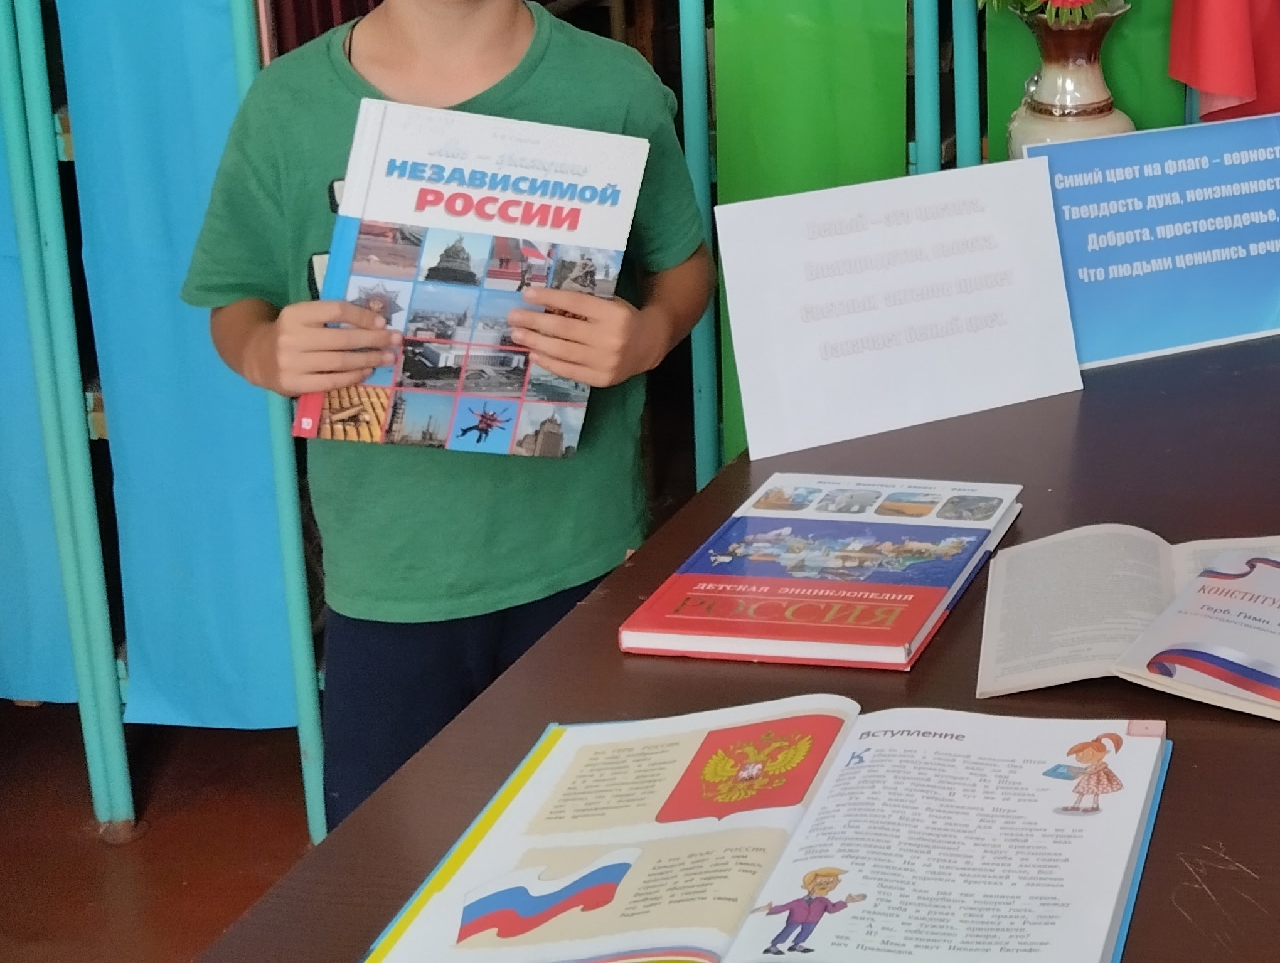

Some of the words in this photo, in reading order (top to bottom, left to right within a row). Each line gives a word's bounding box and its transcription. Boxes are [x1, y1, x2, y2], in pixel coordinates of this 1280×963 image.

[386, 159, 621, 207] НЕЗАВИСИМОЙ
[1054, 168, 1103, 189] Синий
[1106, 165, 1140, 184] цвет
[1144, 161, 1161, 177] на
[1164, 155, 1209, 175] флаге
[414, 187, 582, 232] РОССИИ
[1063, 199, 1143, 221] Твердость
[1147, 192, 1184, 210] духа,
[1156, 208, 1280, 240] простосердечье,
[1078, 267, 1105, 283] Что
[1109, 255, 1173, 280] людьми
[1176, 243, 1247, 269] ценились
[692, 582, 771, 594] ДЕТСКАЯ
[778, 587, 914, 602] ЭНЦИКЛОПЕДИЯ
[673, 596, 904, 627] РОССИЯ
[858, 728, 967, 743] Вступление
